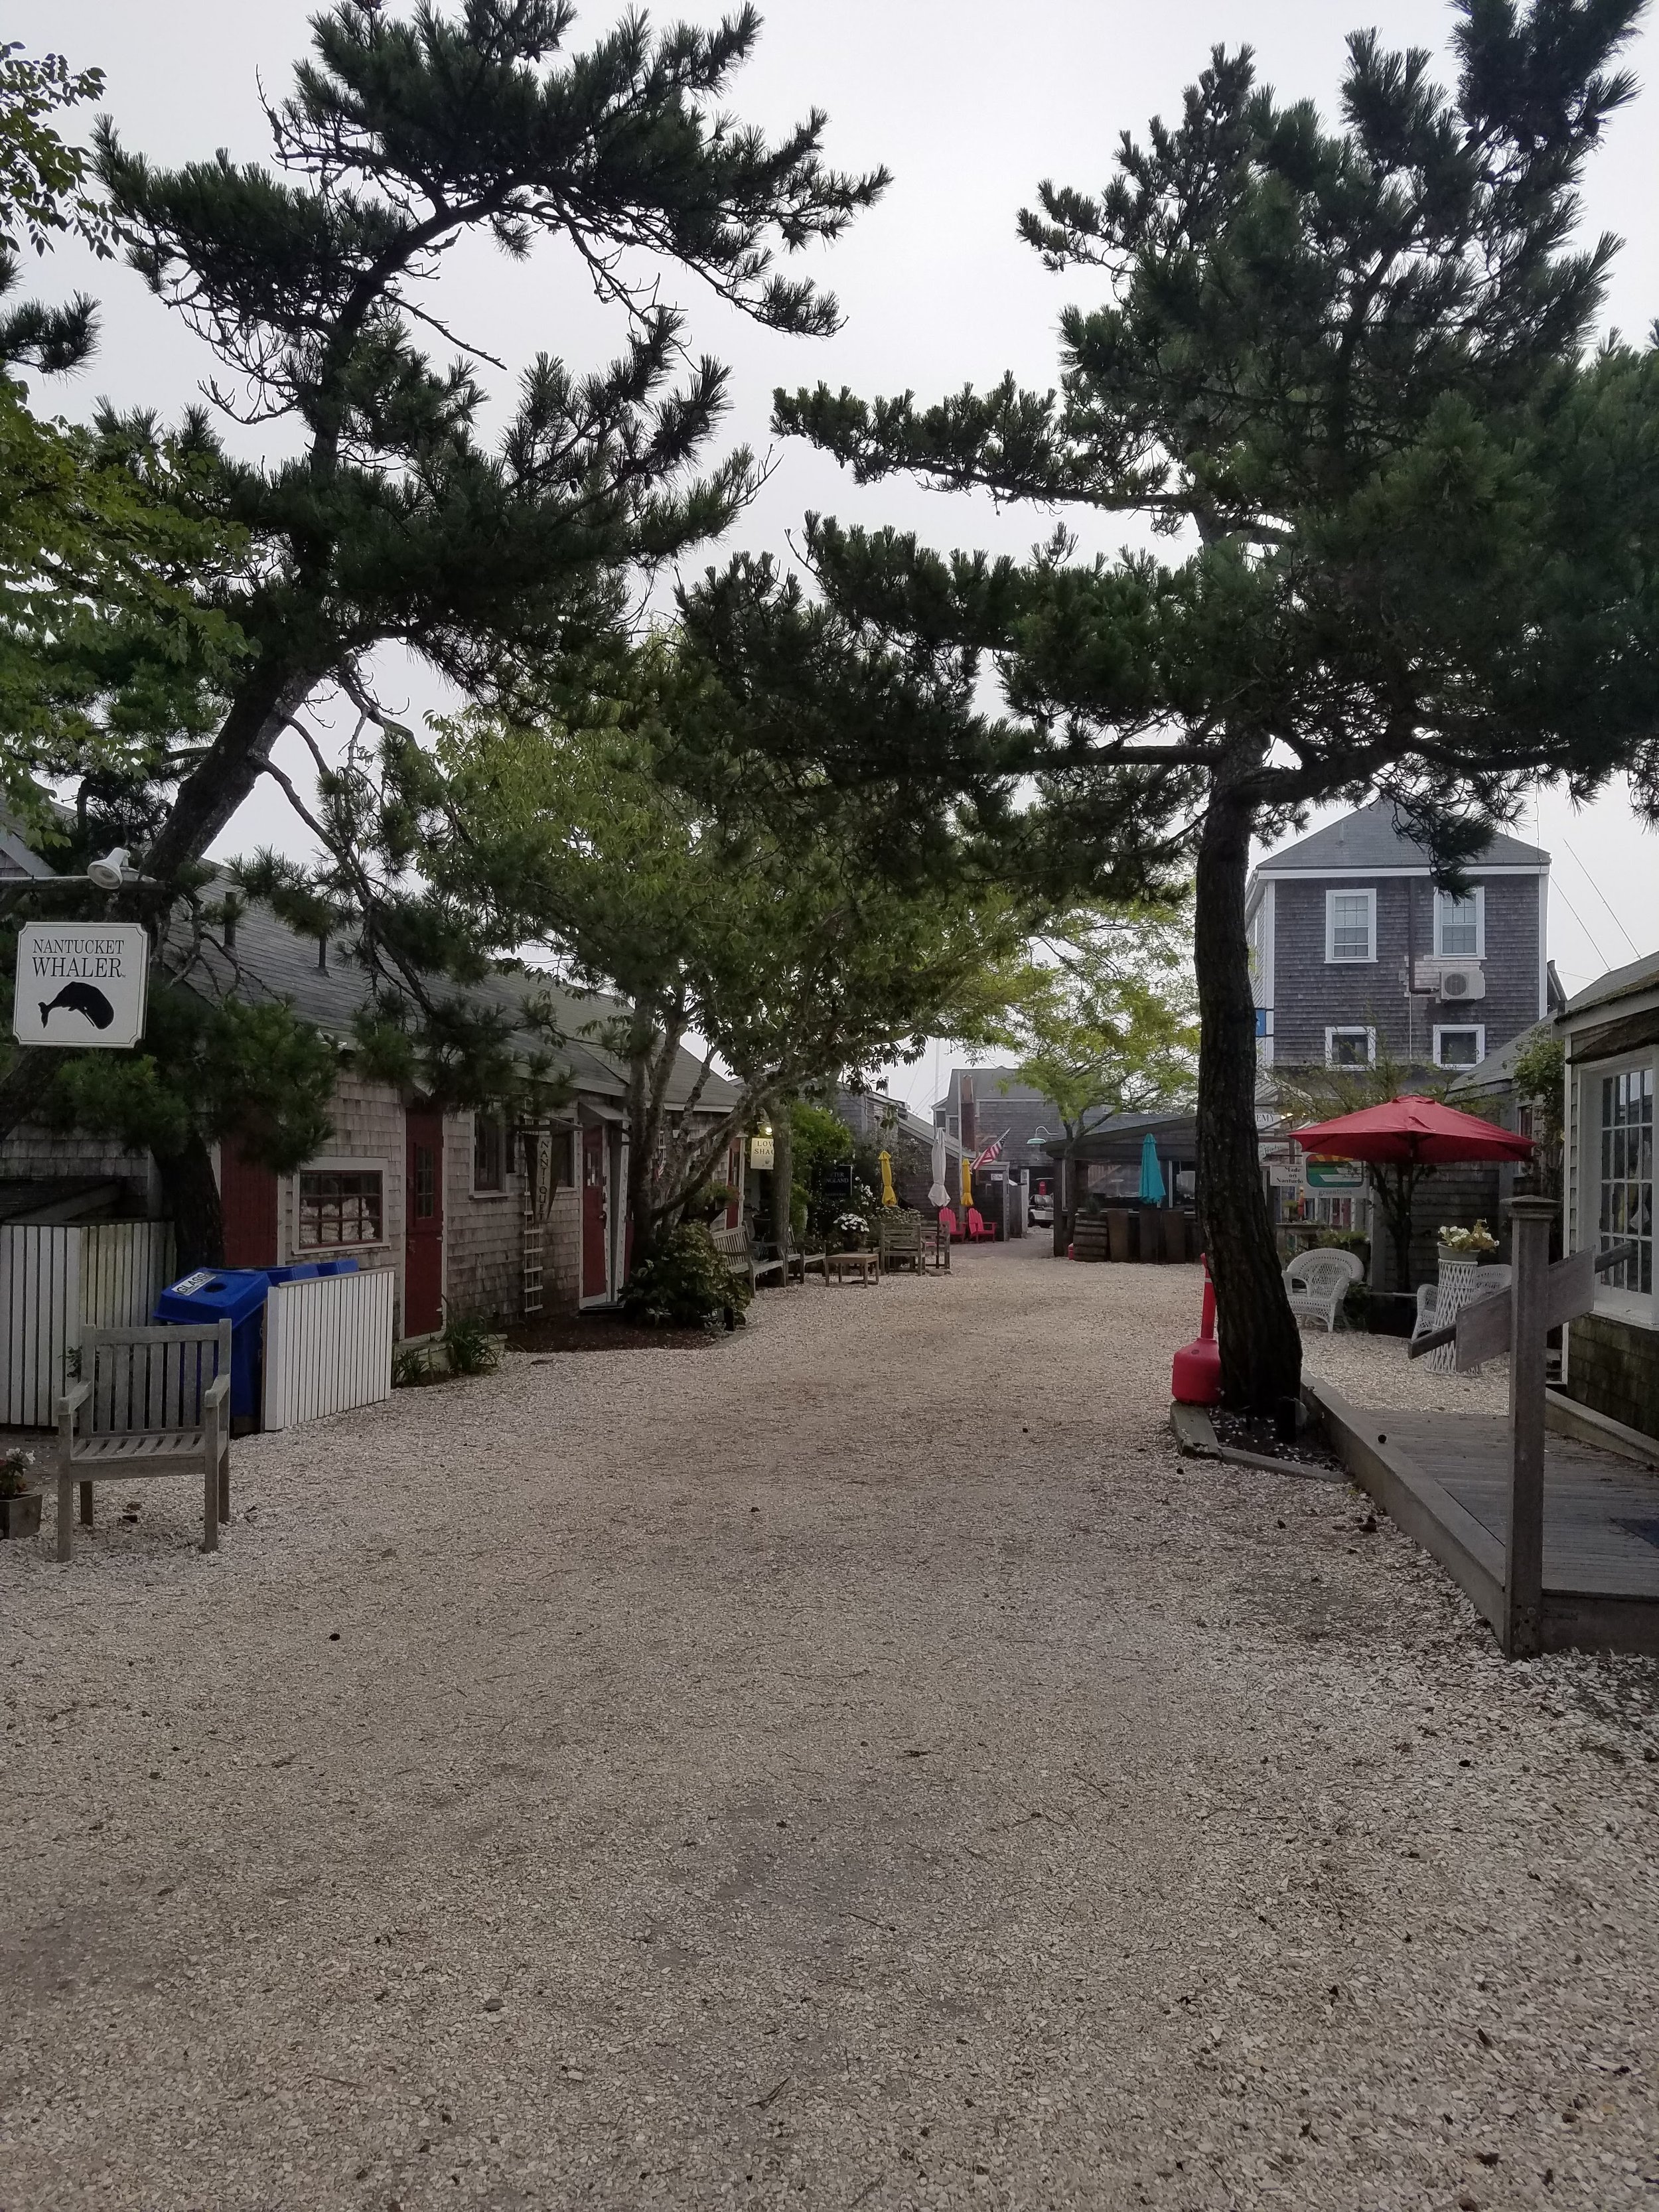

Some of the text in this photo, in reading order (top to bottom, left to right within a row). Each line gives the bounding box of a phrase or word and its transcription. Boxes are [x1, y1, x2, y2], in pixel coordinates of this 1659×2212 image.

[33, 939, 125, 954] NANTUCKET
[32, 956, 123, 978] WHALER
[539, 1141, 549, 1221] NANTIQUET
[177, 1274, 208, 1293] GLASS
